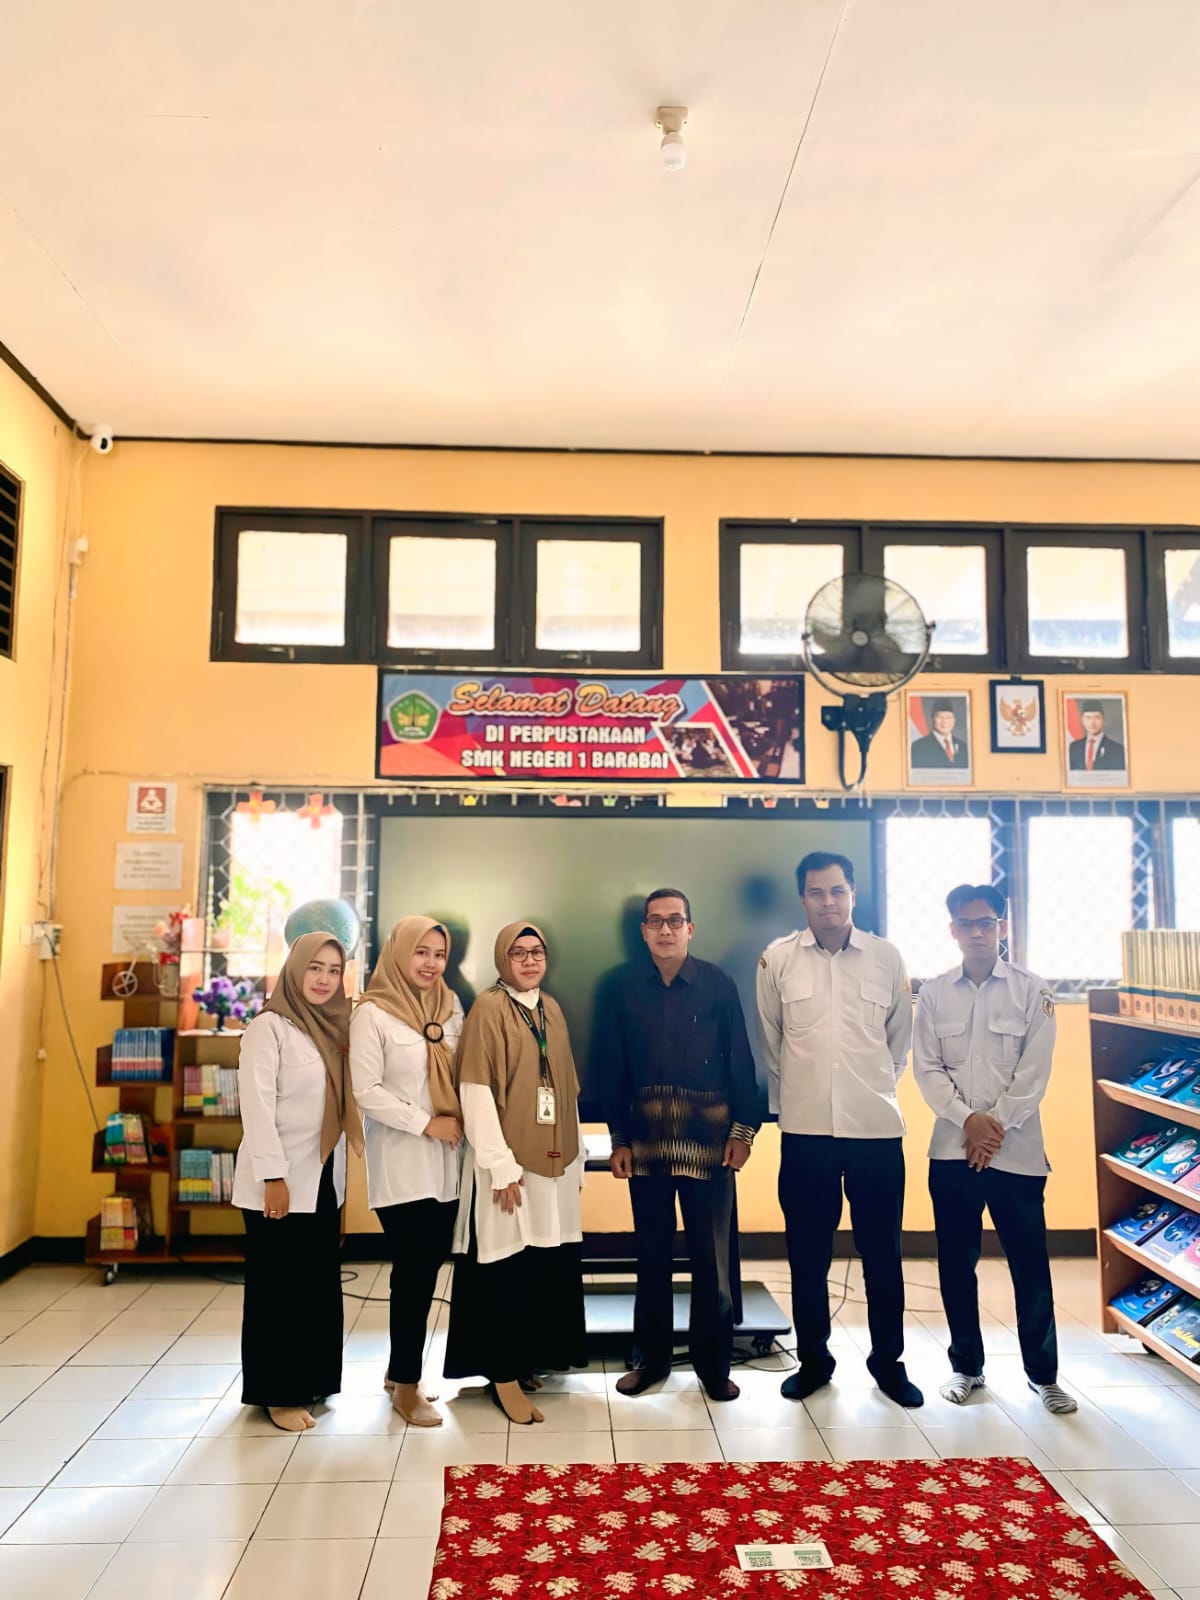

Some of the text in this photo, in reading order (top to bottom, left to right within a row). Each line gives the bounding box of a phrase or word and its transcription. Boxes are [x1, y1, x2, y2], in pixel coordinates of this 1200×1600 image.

[450, 682, 567, 716] Selamat
[577, 683, 682, 721] Datang
[485, 725, 646, 745] DI PERPUSTAKAAN
[461, 749, 669, 769] SMK NEGERI 1 BARABAI
